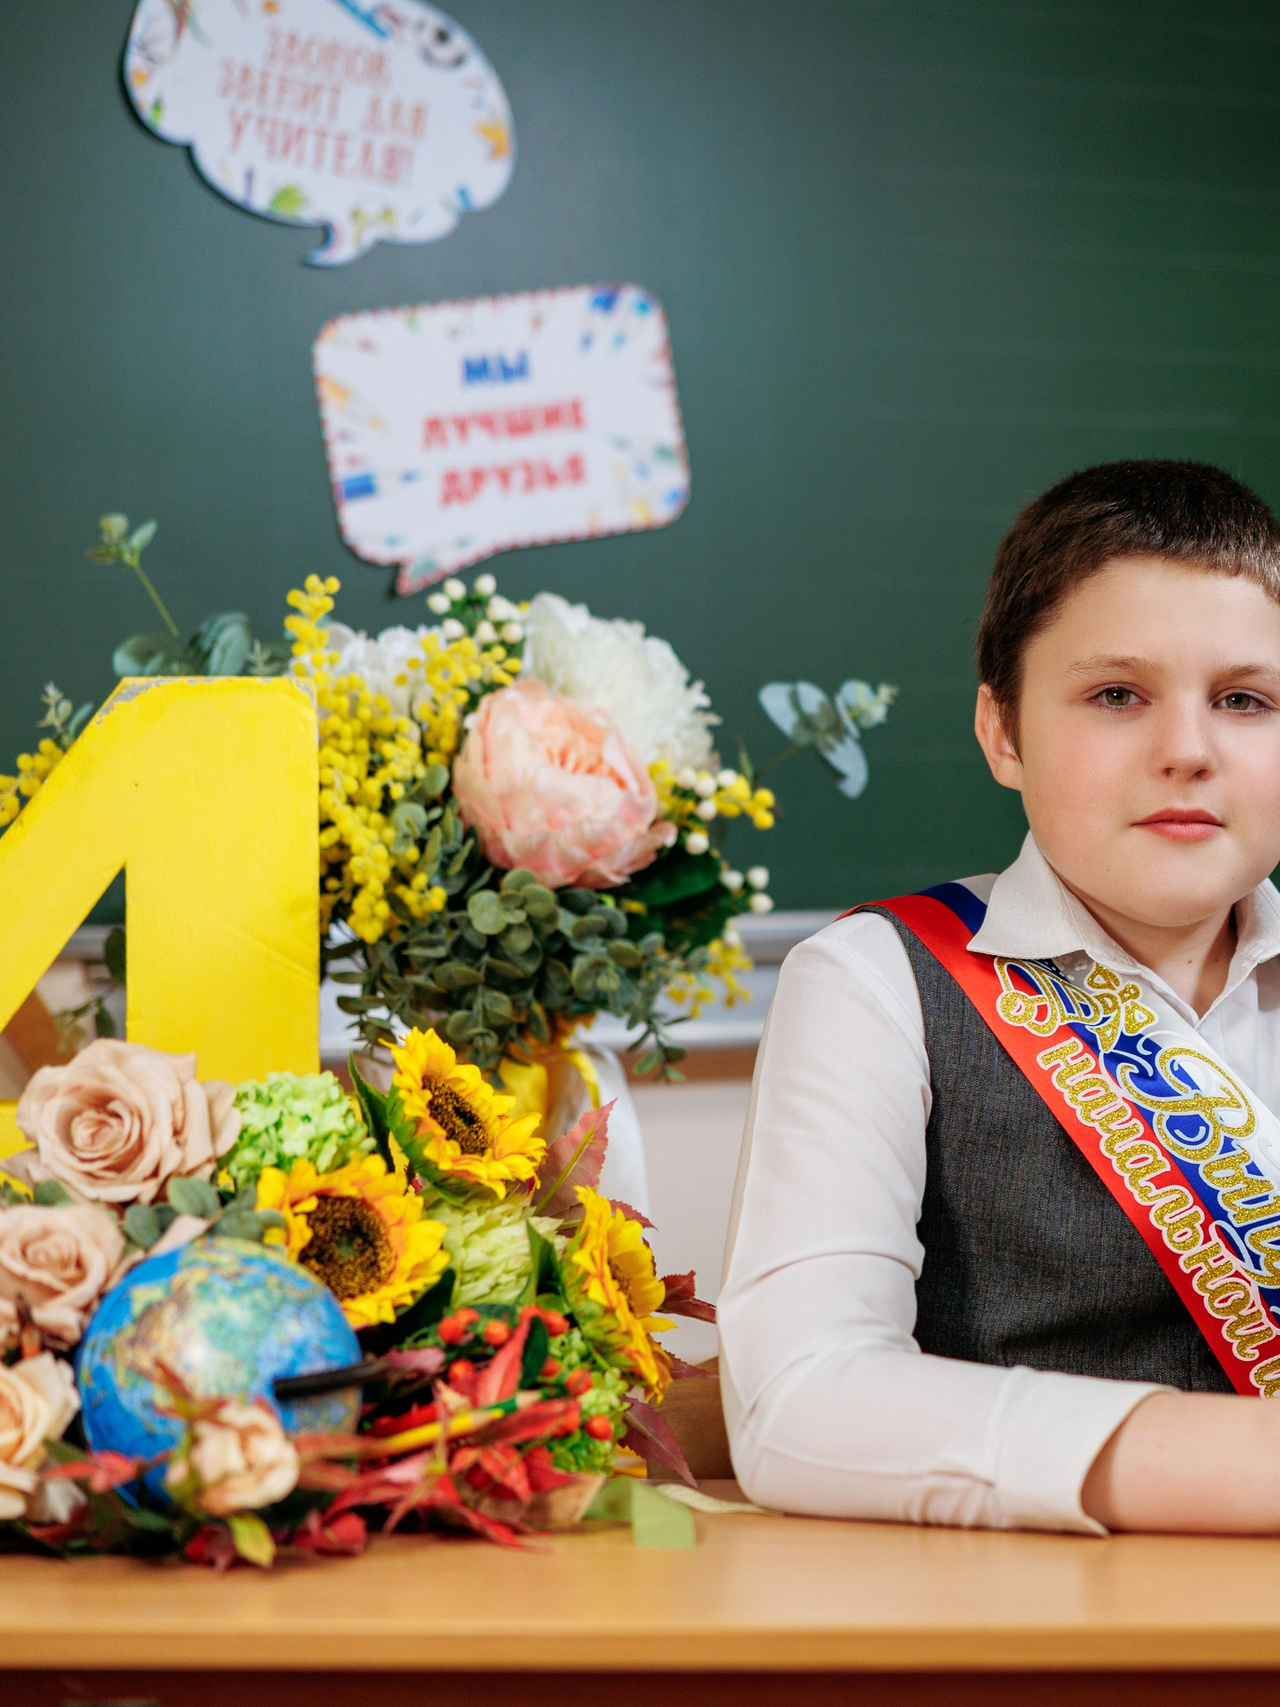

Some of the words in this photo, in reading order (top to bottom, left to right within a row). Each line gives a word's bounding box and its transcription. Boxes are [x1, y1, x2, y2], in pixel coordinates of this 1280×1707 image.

[461, 349, 530, 387] МЫ
[422, 396, 584, 449] ЛУЧШИЕ
[440, 454, 584, 507] ДРУЗЬЯ
[1037, 1036, 1276, 1361] начальной
